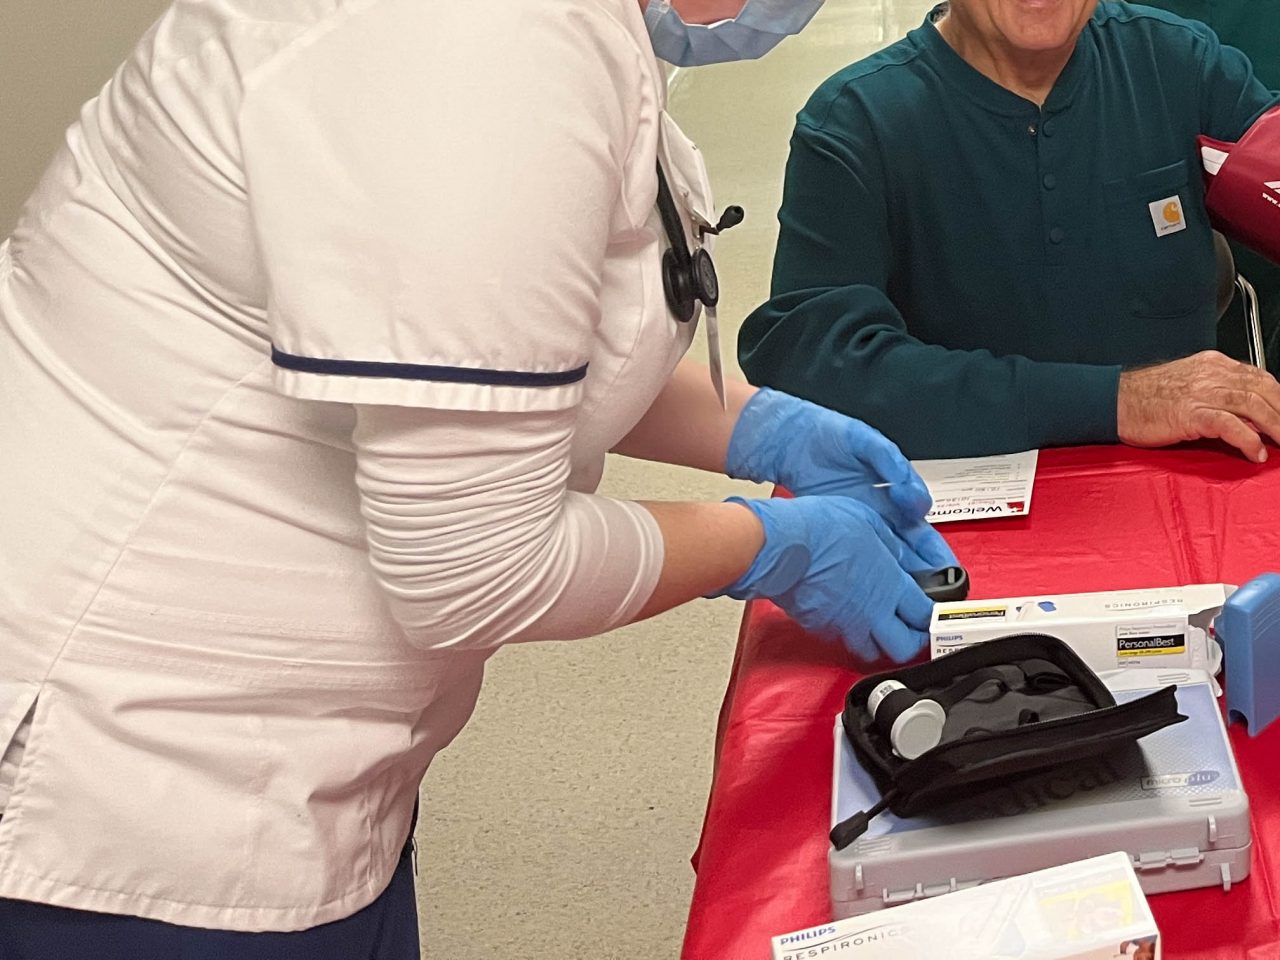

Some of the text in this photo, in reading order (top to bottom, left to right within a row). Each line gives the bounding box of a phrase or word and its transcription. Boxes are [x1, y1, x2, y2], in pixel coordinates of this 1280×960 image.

[928, 505, 1003, 516] Welcome
[1119, 637, 1175, 649] PersonalBest
[780, 926, 836, 945] PHILIPS
